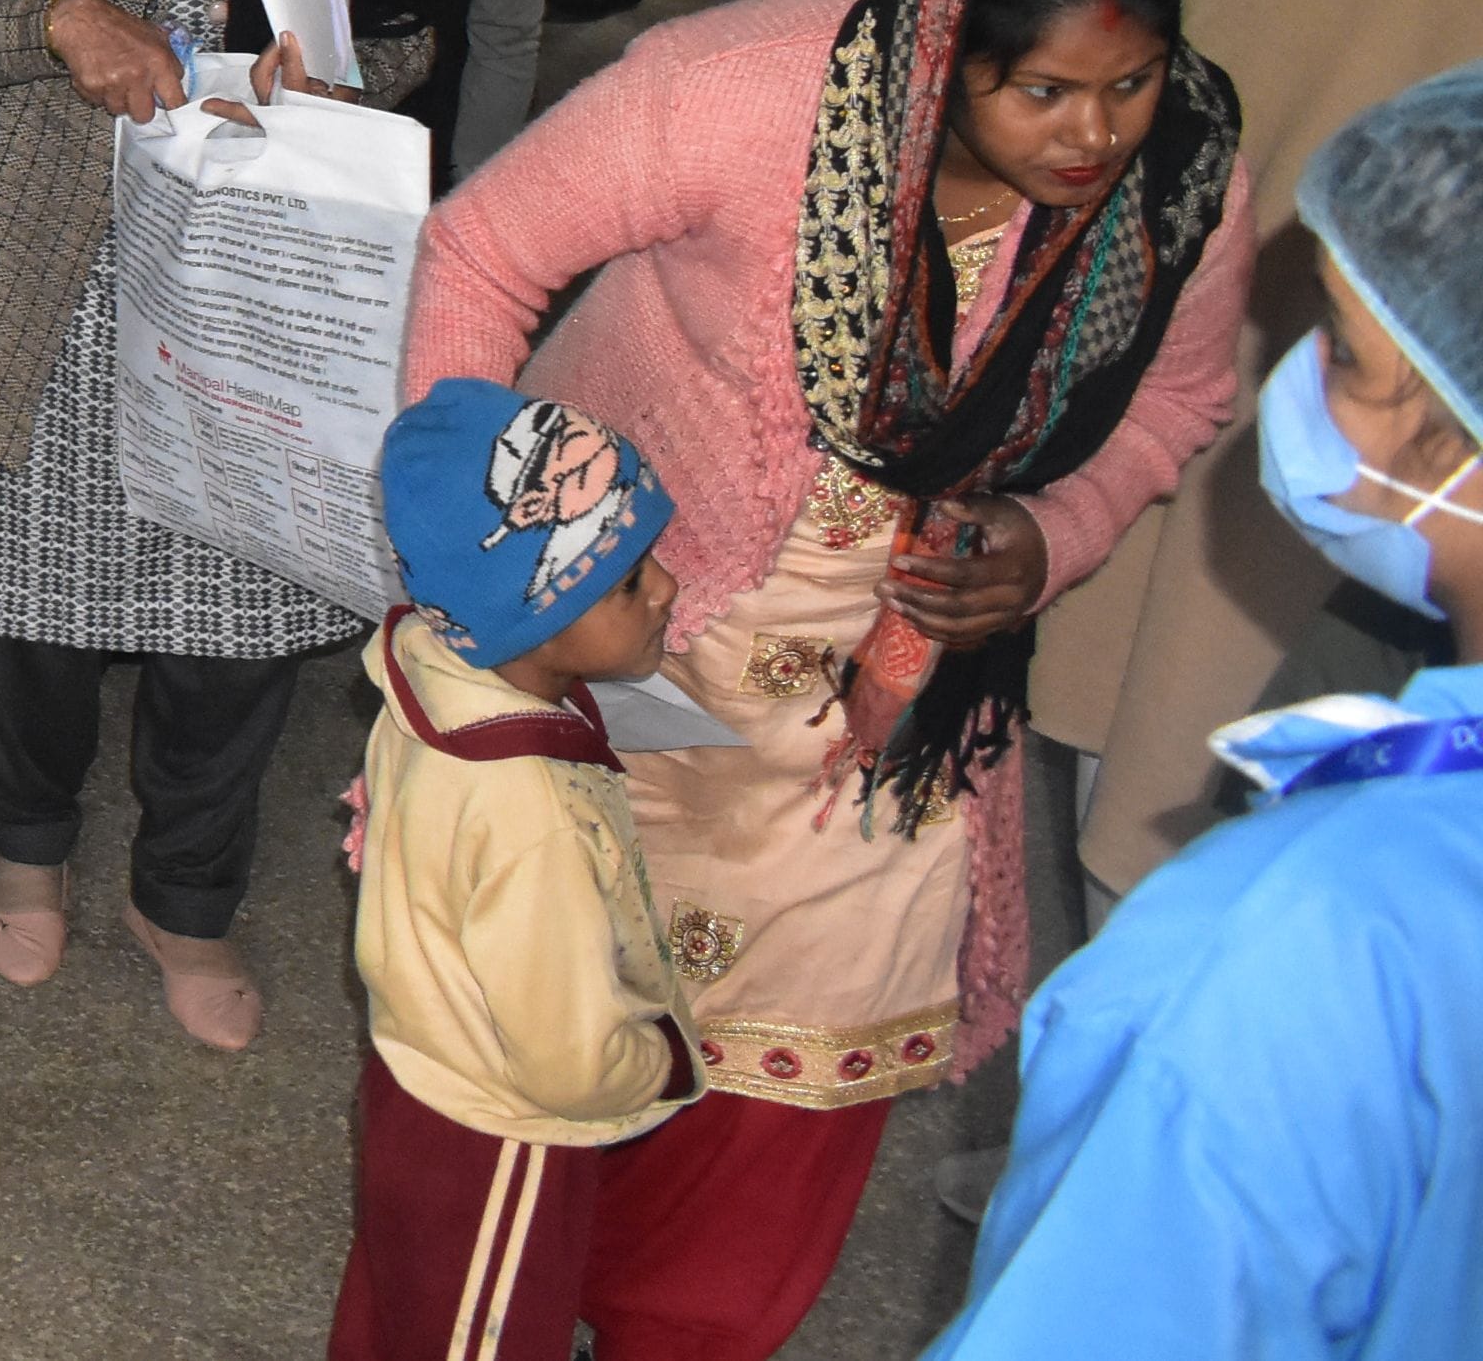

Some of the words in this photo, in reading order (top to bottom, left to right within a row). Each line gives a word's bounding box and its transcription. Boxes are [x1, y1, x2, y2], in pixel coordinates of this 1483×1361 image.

[193, 185, 261, 203] IAGNOSTICS
[262, 191, 285, 207] PVT.
[287, 196, 310, 211] LTD.
[175, 358, 225, 391] Manipal
[226, 379, 301, 418] HealthMap
